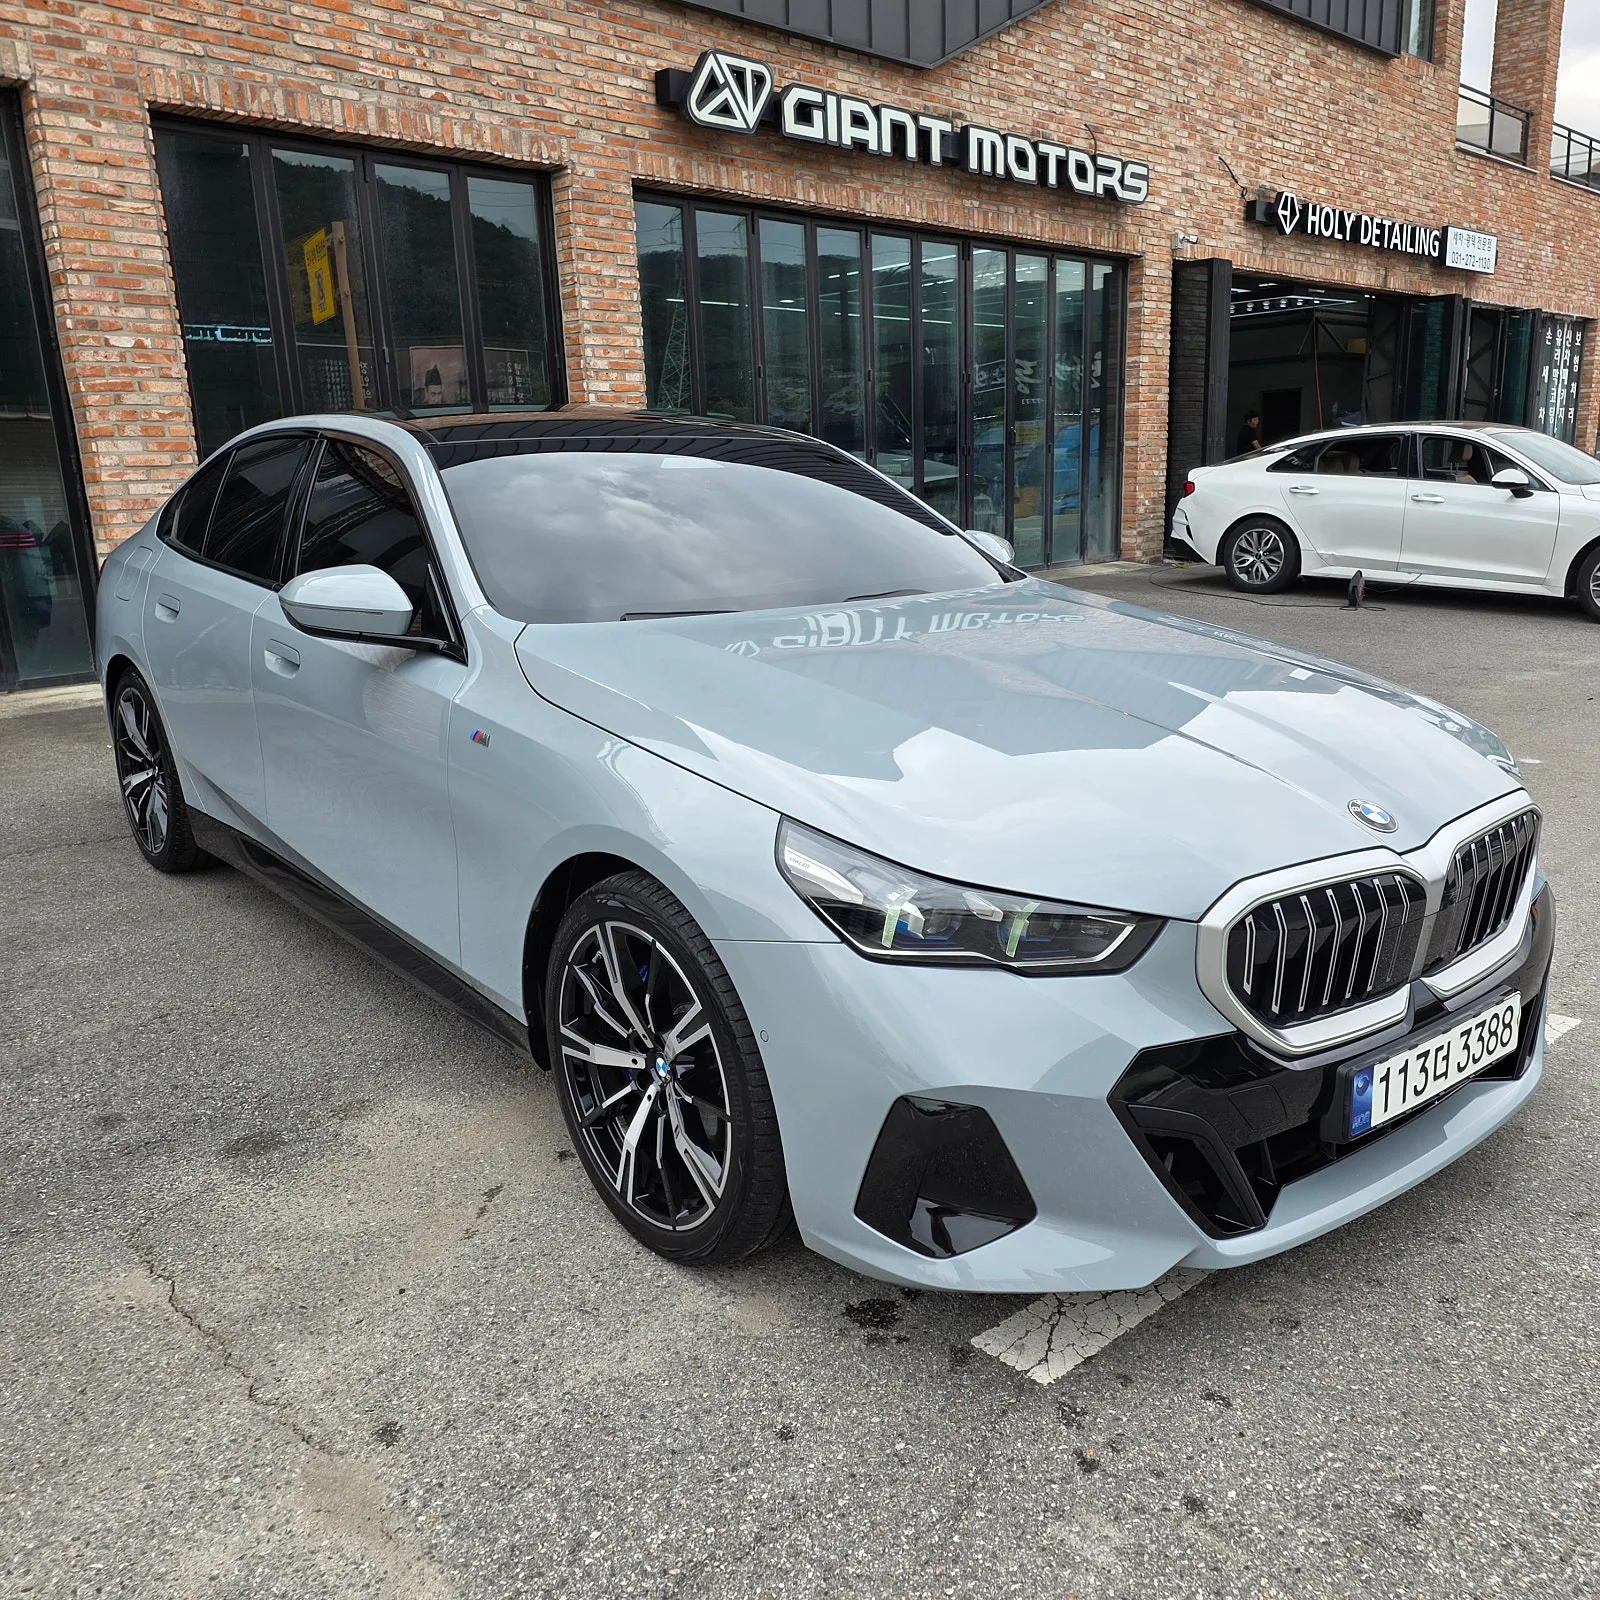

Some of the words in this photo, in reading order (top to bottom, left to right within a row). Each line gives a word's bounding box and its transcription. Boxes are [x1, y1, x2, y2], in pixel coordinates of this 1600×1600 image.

[783, 88, 953, 165] GIANT
[968, 127, 1149, 201] MOTORS
[1307, 202, 1356, 241] HOLY
[1360, 214, 1441, 258] DETAILING
[1451, 251, 1491, 270] 031-272-1130
[1379, 1041, 1451, 1114] 113더
[1457, 1005, 1514, 1074] 3388
